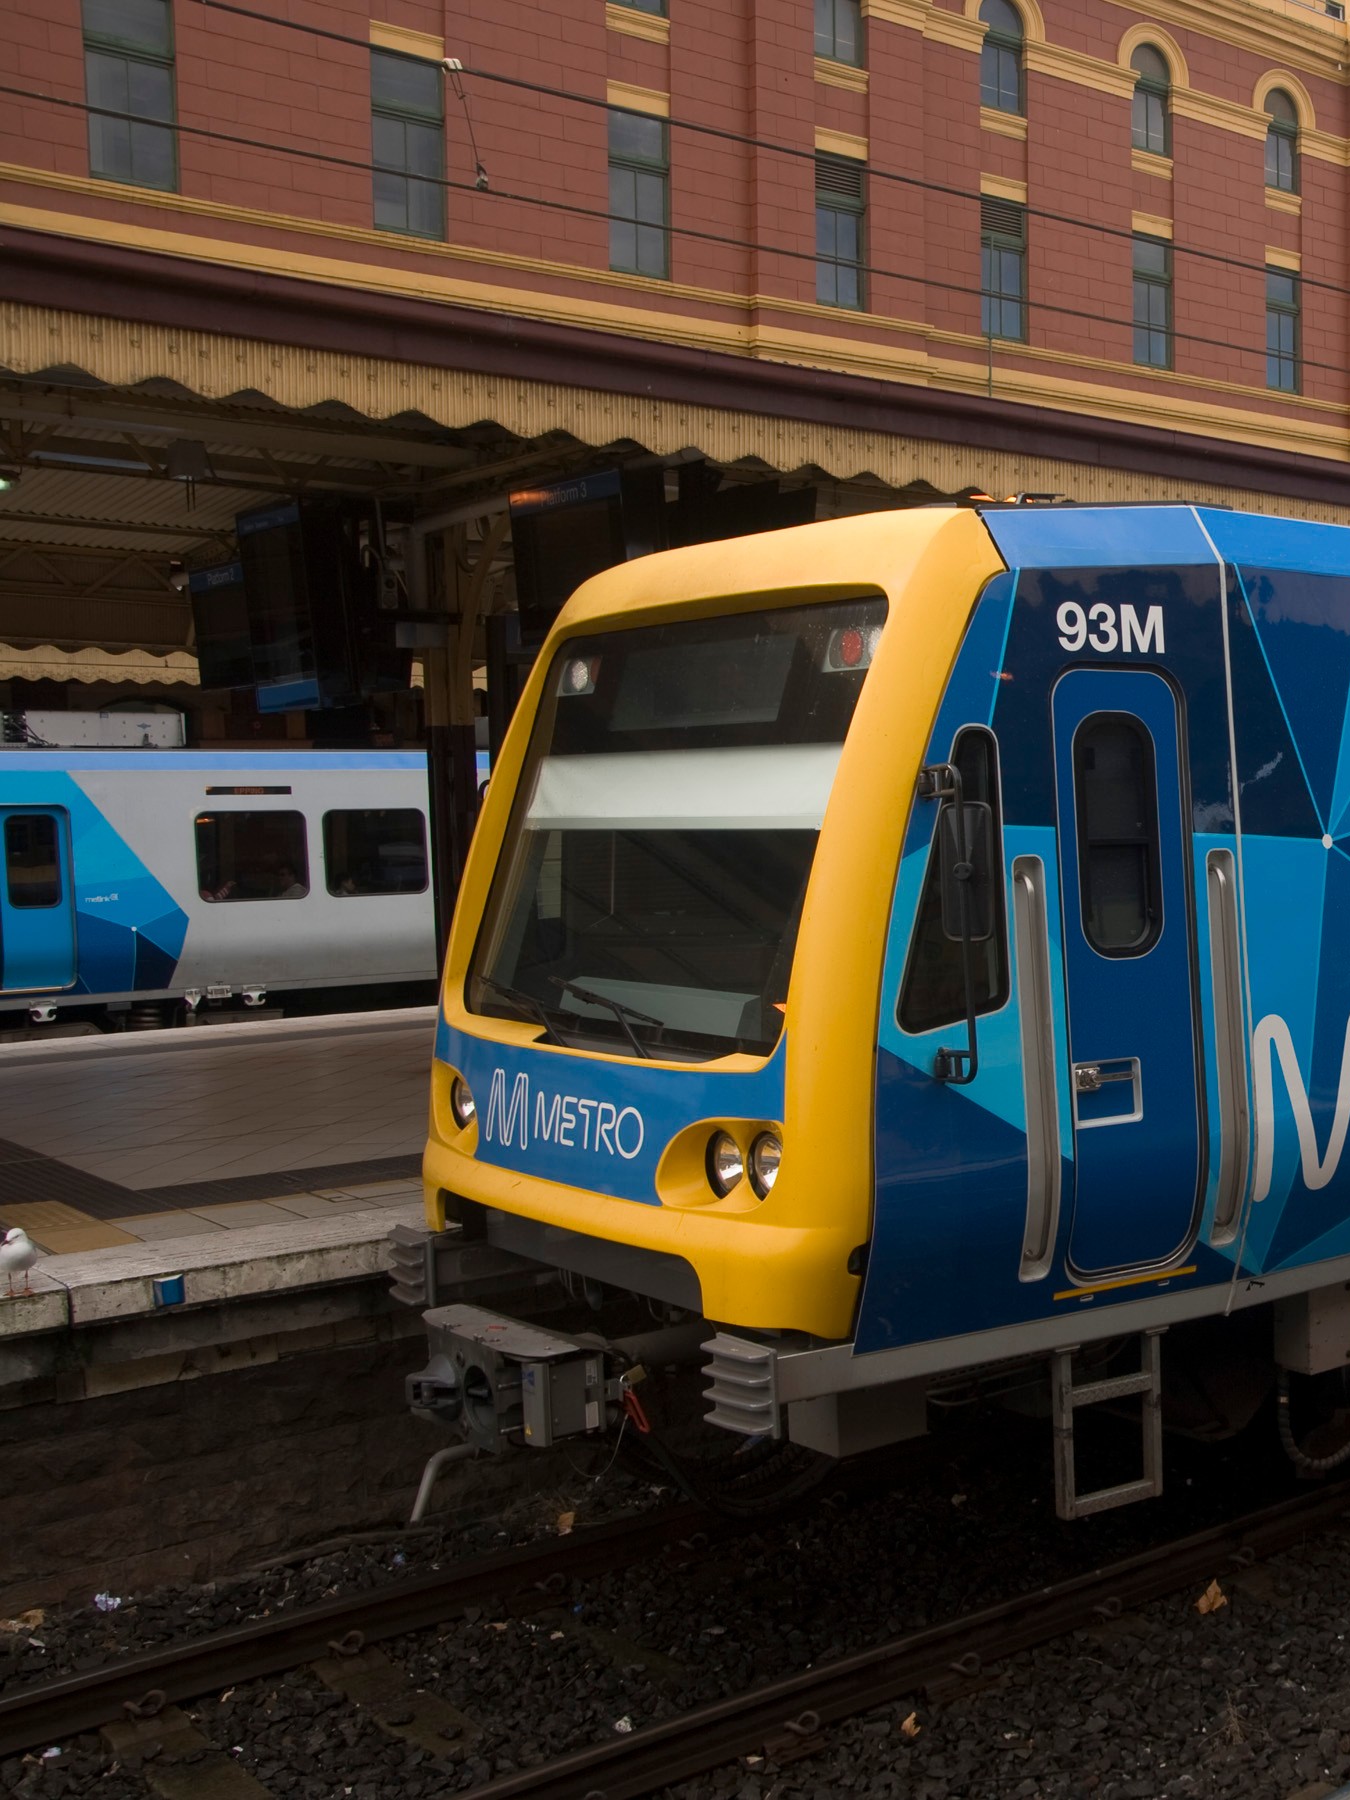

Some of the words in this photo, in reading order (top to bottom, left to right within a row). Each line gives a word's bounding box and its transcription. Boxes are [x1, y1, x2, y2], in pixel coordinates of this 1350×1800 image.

[541, 487, 579, 507] Platform
[580, 481, 588, 498] 3
[1056, 601, 1165, 653] 93M
[534, 1091, 644, 1159] METRO
